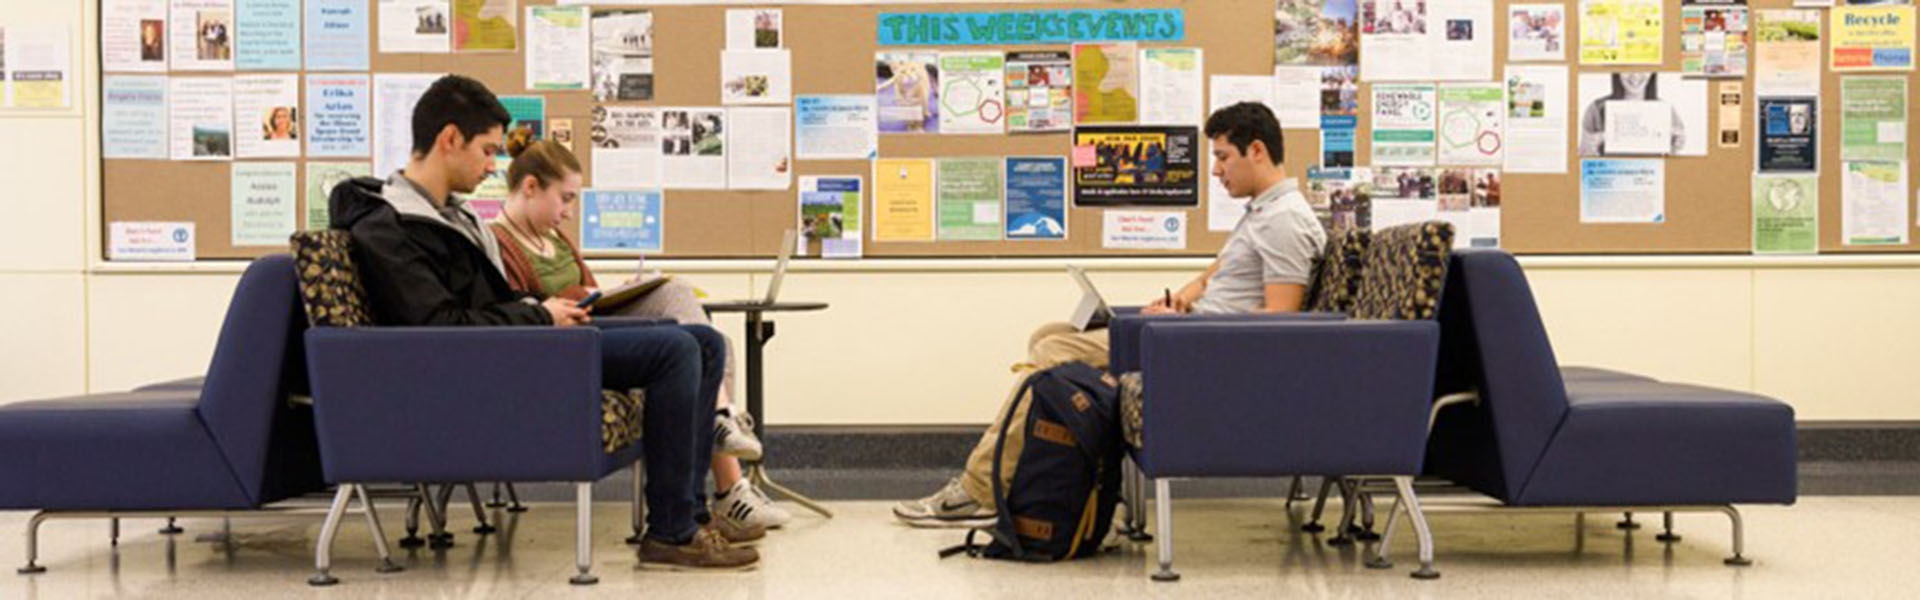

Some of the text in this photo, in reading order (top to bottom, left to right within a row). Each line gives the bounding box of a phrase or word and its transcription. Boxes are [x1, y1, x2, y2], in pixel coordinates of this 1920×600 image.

[882, 14, 960, 42] THIS
[1067, 11, 1176, 39] EVENTS
[1845, 13, 1900, 27] Recycle
